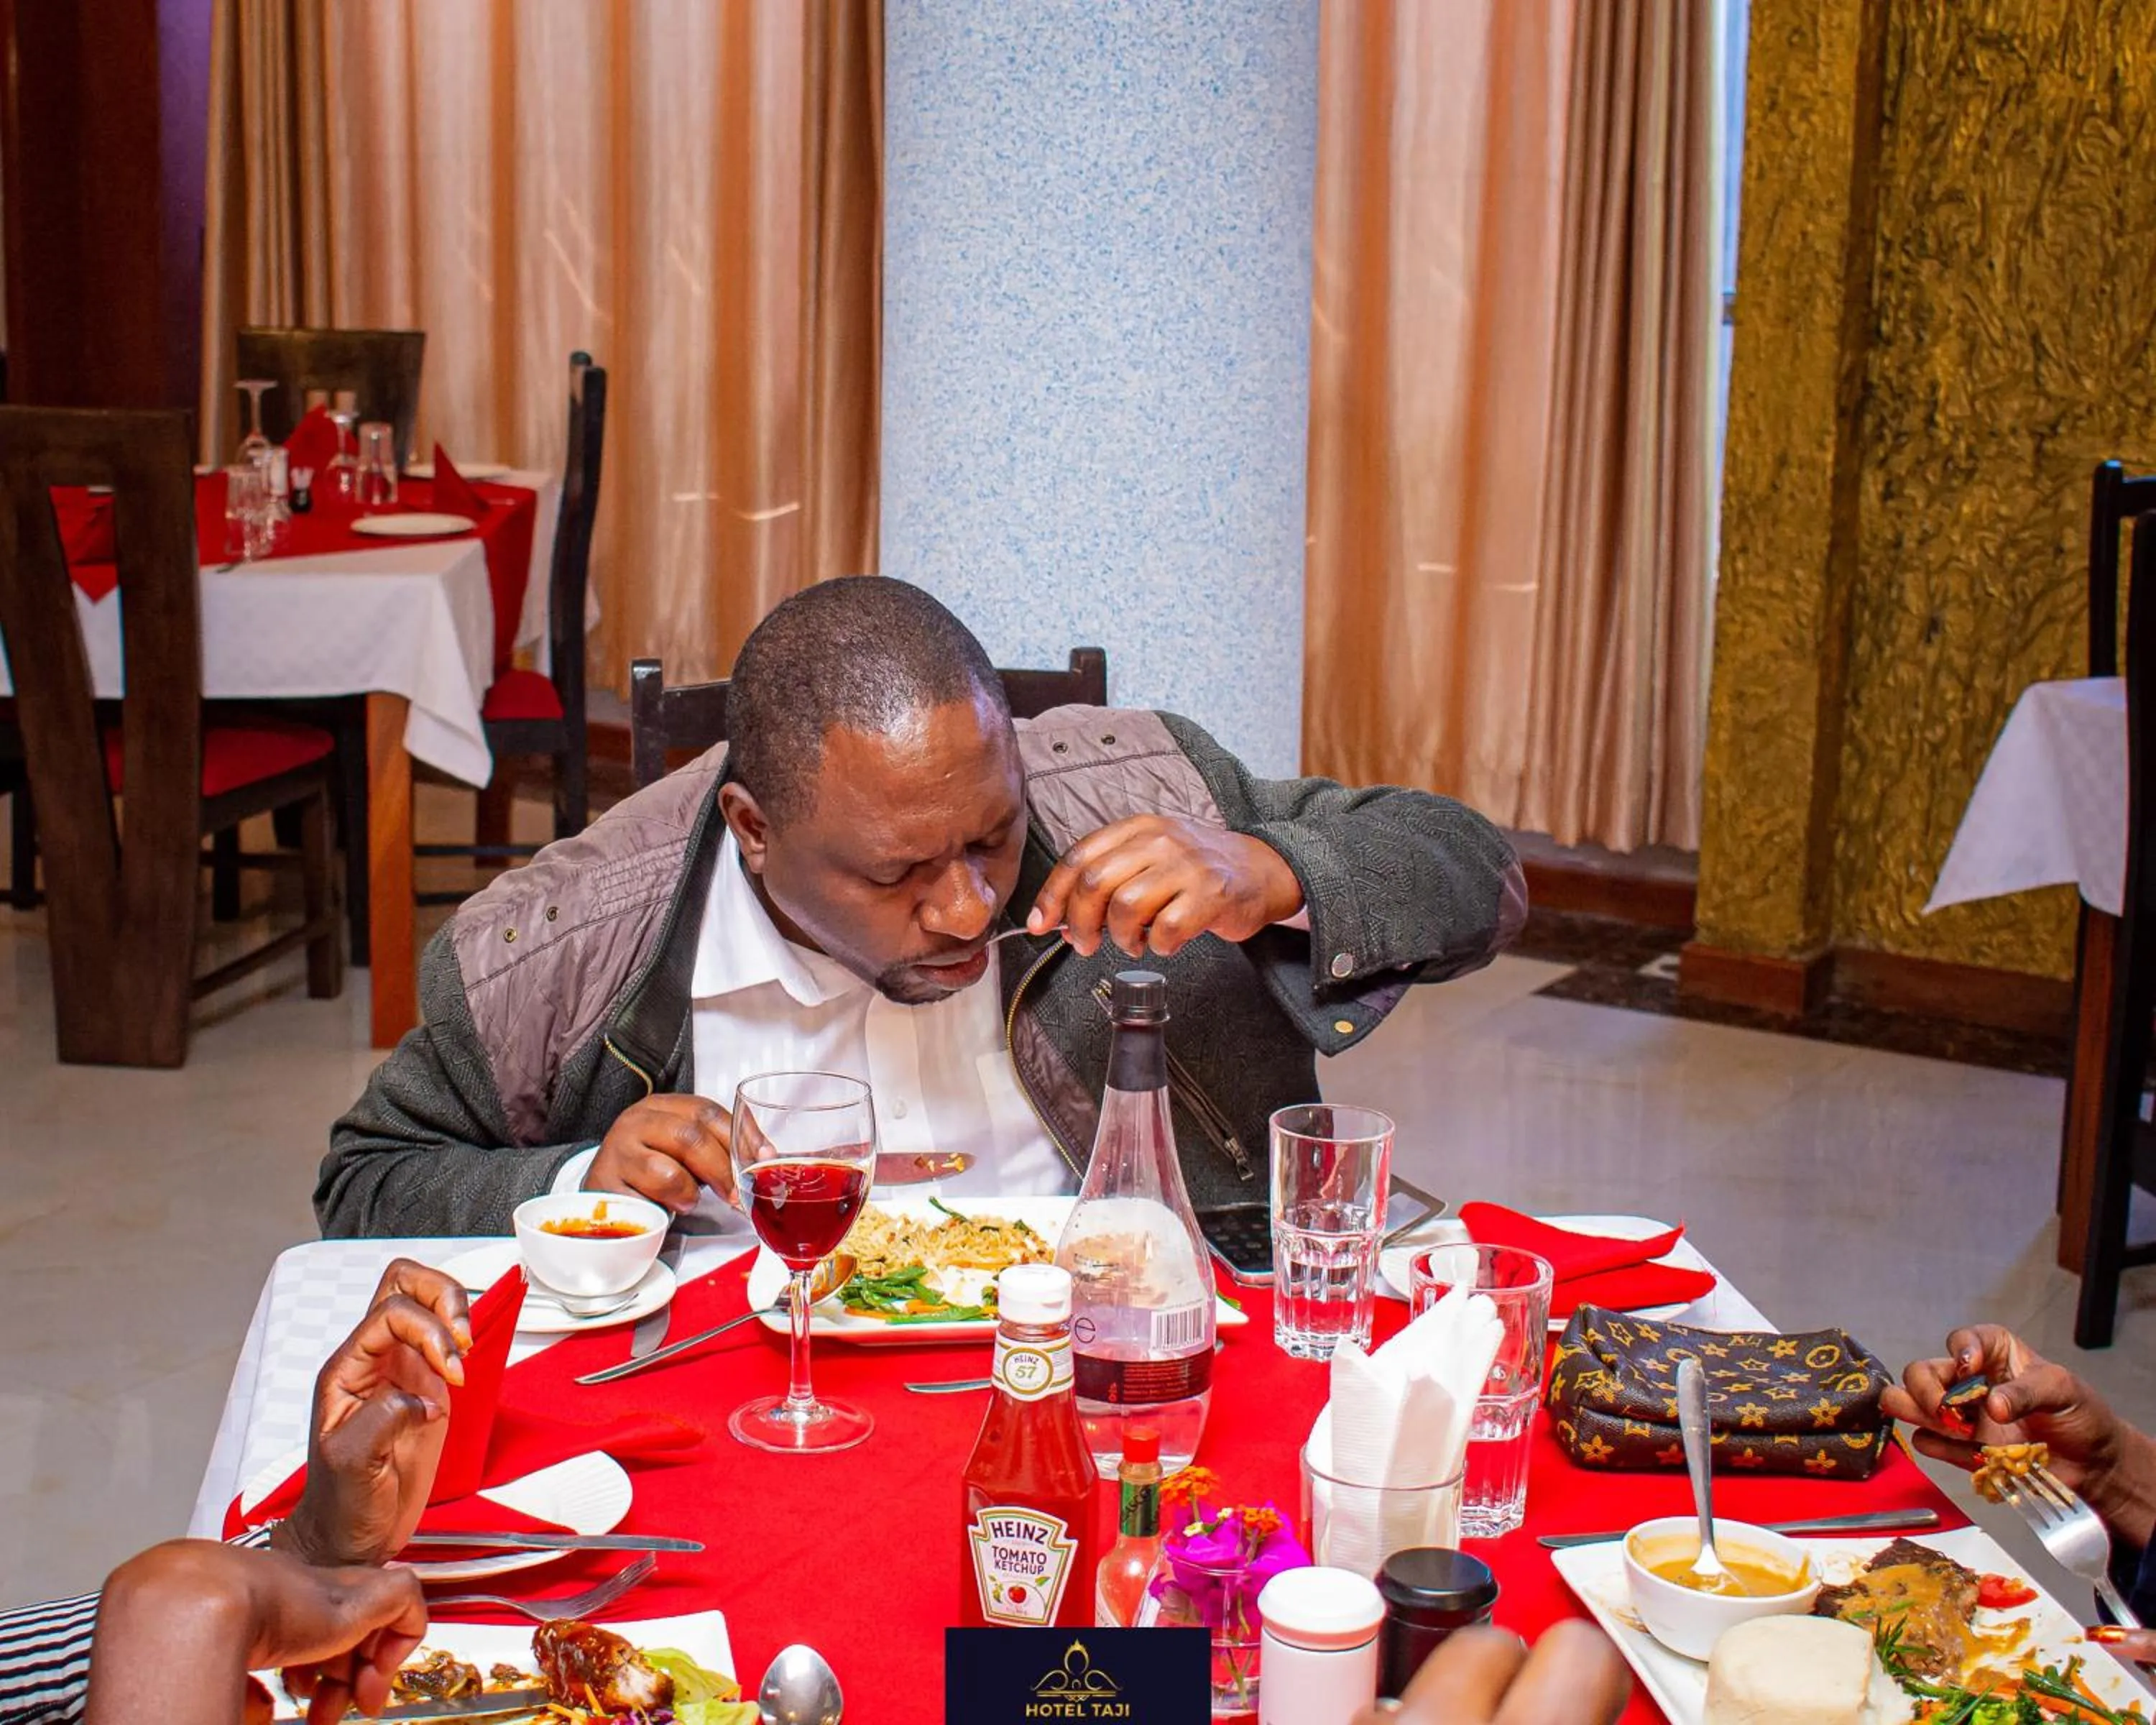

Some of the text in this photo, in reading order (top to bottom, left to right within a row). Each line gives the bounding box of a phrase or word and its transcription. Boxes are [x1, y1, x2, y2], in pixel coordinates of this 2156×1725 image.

[1013, 1354, 1040, 1365] HEINZ
[1015, 1365, 1037, 1379] 57
[990, 1520, 1049, 1545] HEINZ
[992, 1545, 1047, 1565] TOMATO
[994, 1559, 1044, 1575] KETCHUP
